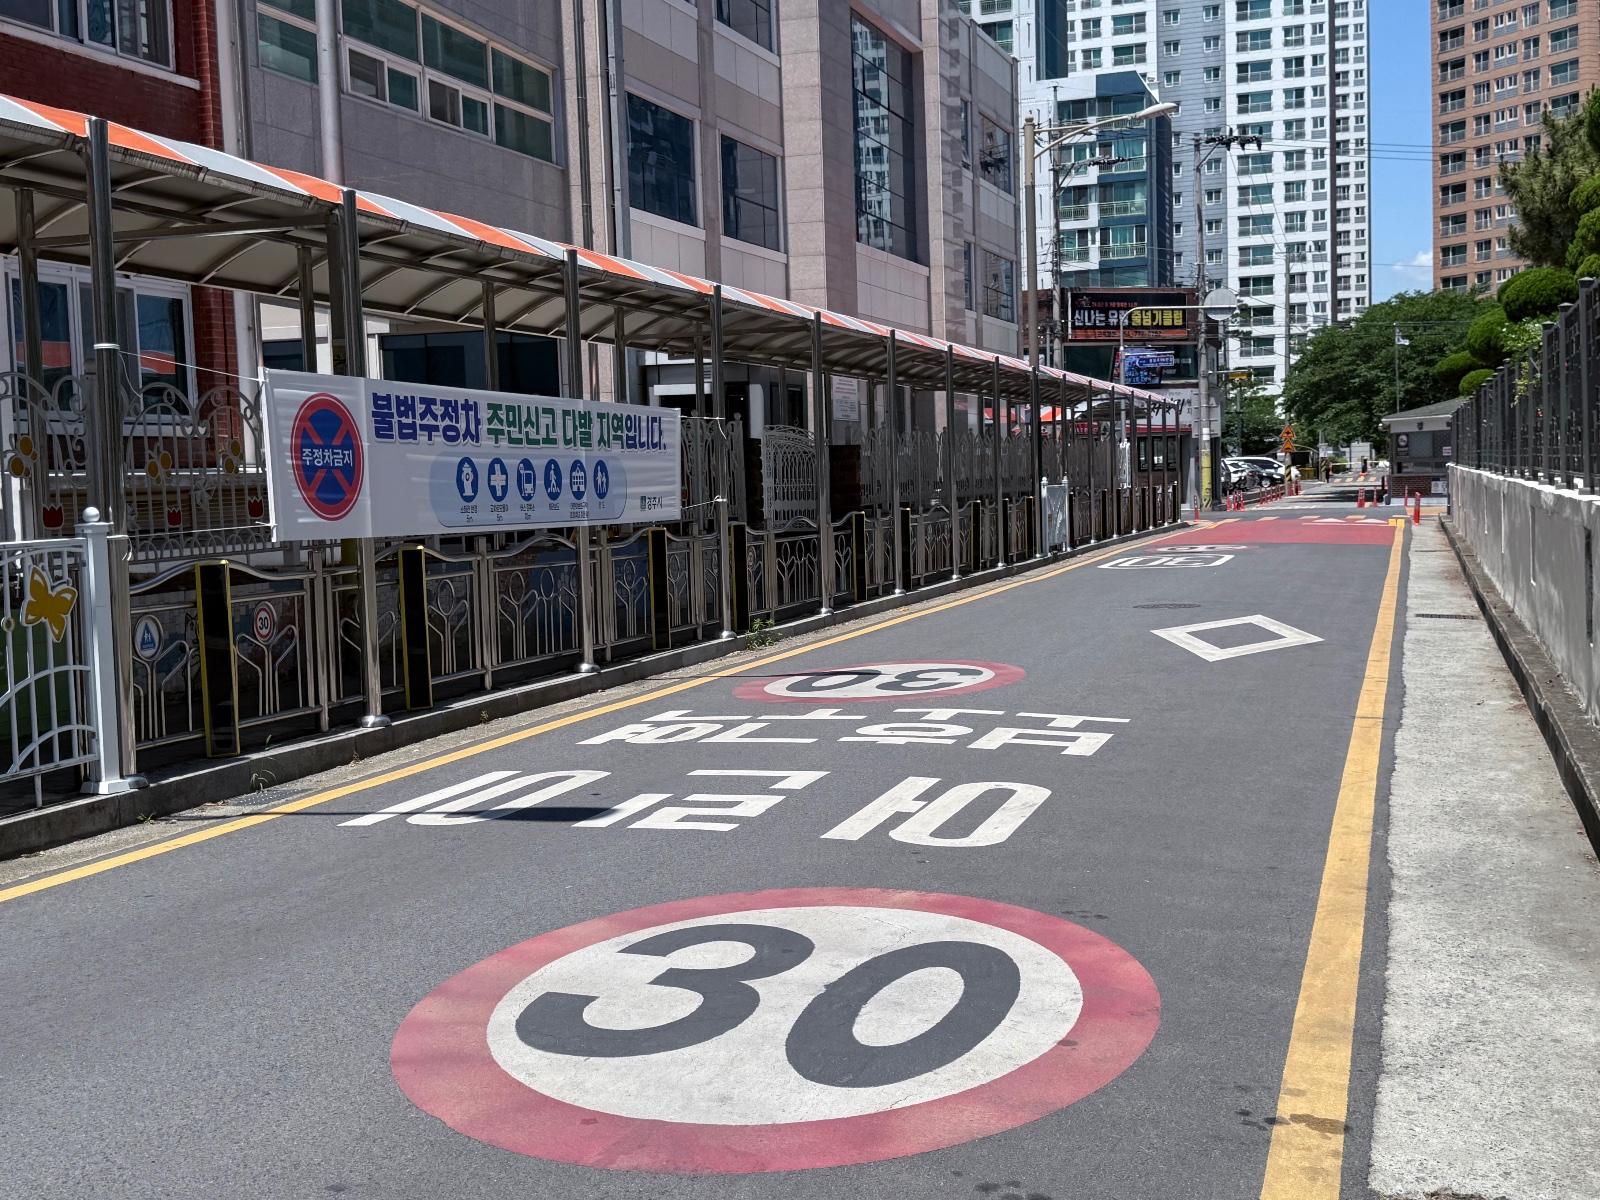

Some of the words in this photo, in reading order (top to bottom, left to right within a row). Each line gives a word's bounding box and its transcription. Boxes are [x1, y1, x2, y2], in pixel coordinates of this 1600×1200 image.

[1074, 310, 1105, 326] 신나는
[1131, 309, 1183, 326] 줄넘기클럽
[371, 392, 481, 444] 불법주정차
[486, 402, 558, 447] 주민신고
[562, 409, 593, 448] 다발
[597, 412, 667, 450] 지역입니다.
[302, 448, 353, 467] 주정차금지
[258, 616, 269, 630] 30
[785, 668, 983, 693] 30
[575, 708, 1131, 756] 보호구역
[337, 769, 1052, 848] 어린이
[514, 923, 1021, 1088] 30
